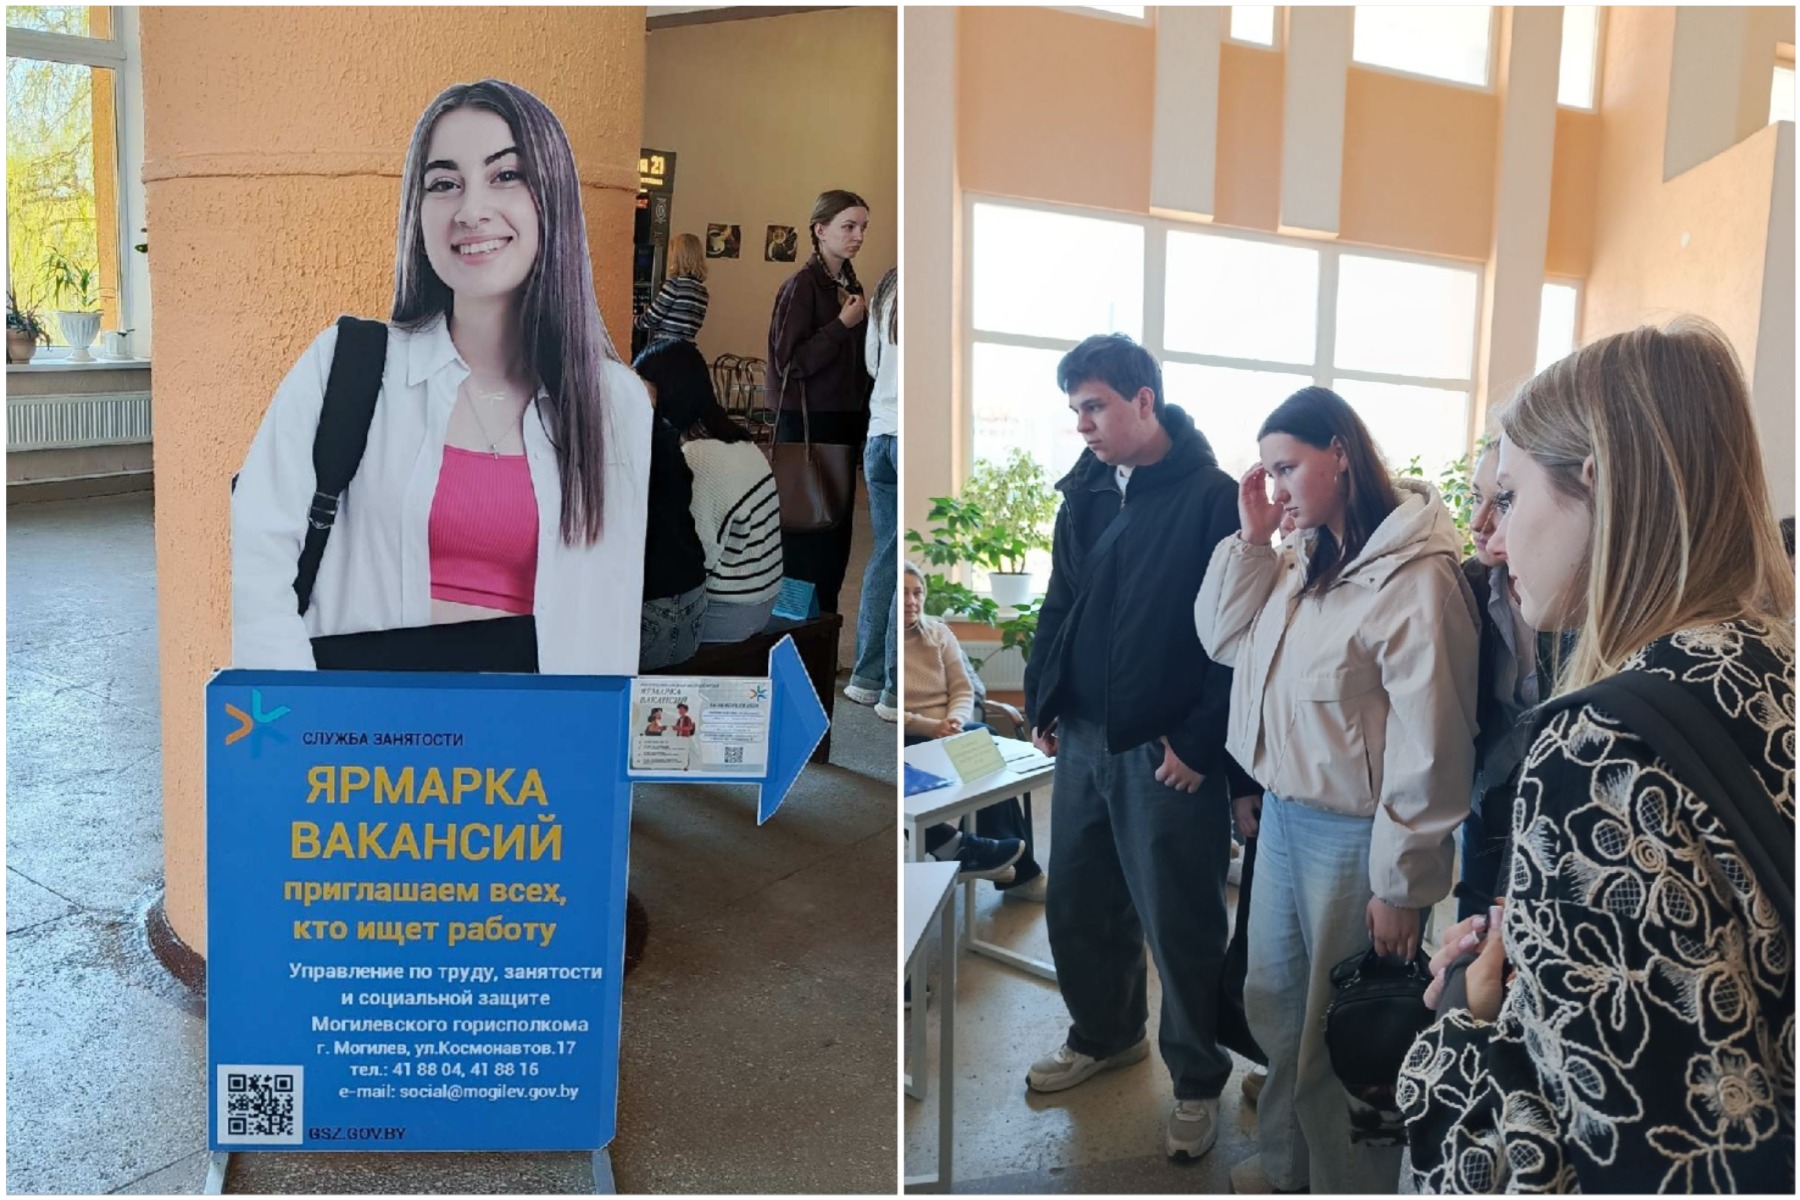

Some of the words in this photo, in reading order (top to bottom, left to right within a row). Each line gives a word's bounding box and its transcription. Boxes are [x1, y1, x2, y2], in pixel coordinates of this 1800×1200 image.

[302, 732, 369, 746] СЛУЖБА
[373, 733, 464, 747] ЗАНЯТОСТИ
[306, 765, 549, 806] ЯРМАРКА
[290, 814, 562, 861] ВАКАНСИЙ
[284, 880, 479, 907] приглашаем
[489, 882, 567, 906] всех,
[293, 919, 348, 941] кто
[356, 920, 440, 946] ищет
[448, 914, 557, 947] работу
[289, 962, 404, 983] Управление
[409, 965, 433, 980] по
[437, 966, 498, 984] труду,
[503, 966, 603, 980] занятости
[341, 992, 354, 1006] и
[358, 989, 473, 1008] социальной
[478, 992, 551, 1008] защите
[311, 1016, 448, 1033] Могилевского
[453, 1018, 589, 1035] горисполкома
[316, 1043, 330, 1055] г.
[333, 1040, 412, 1057] Могилев,
[349, 1062, 388, 1077] тел.:
[391, 1062, 411, 1077] 41
[416, 1062, 438, 1077] 88
[441, 1062, 466, 1079] 04,
[469, 1062, 488, 1077] 41
[493, 1062, 515, 1077] 88
[519, 1062, 540, 1077] 16
[338, 1083, 396, 1099] e-mail:
[399, 1082, 580, 1102] social@mogilev.gov.by
[308, 1127, 407, 1141] GSZ.GOV.BY
